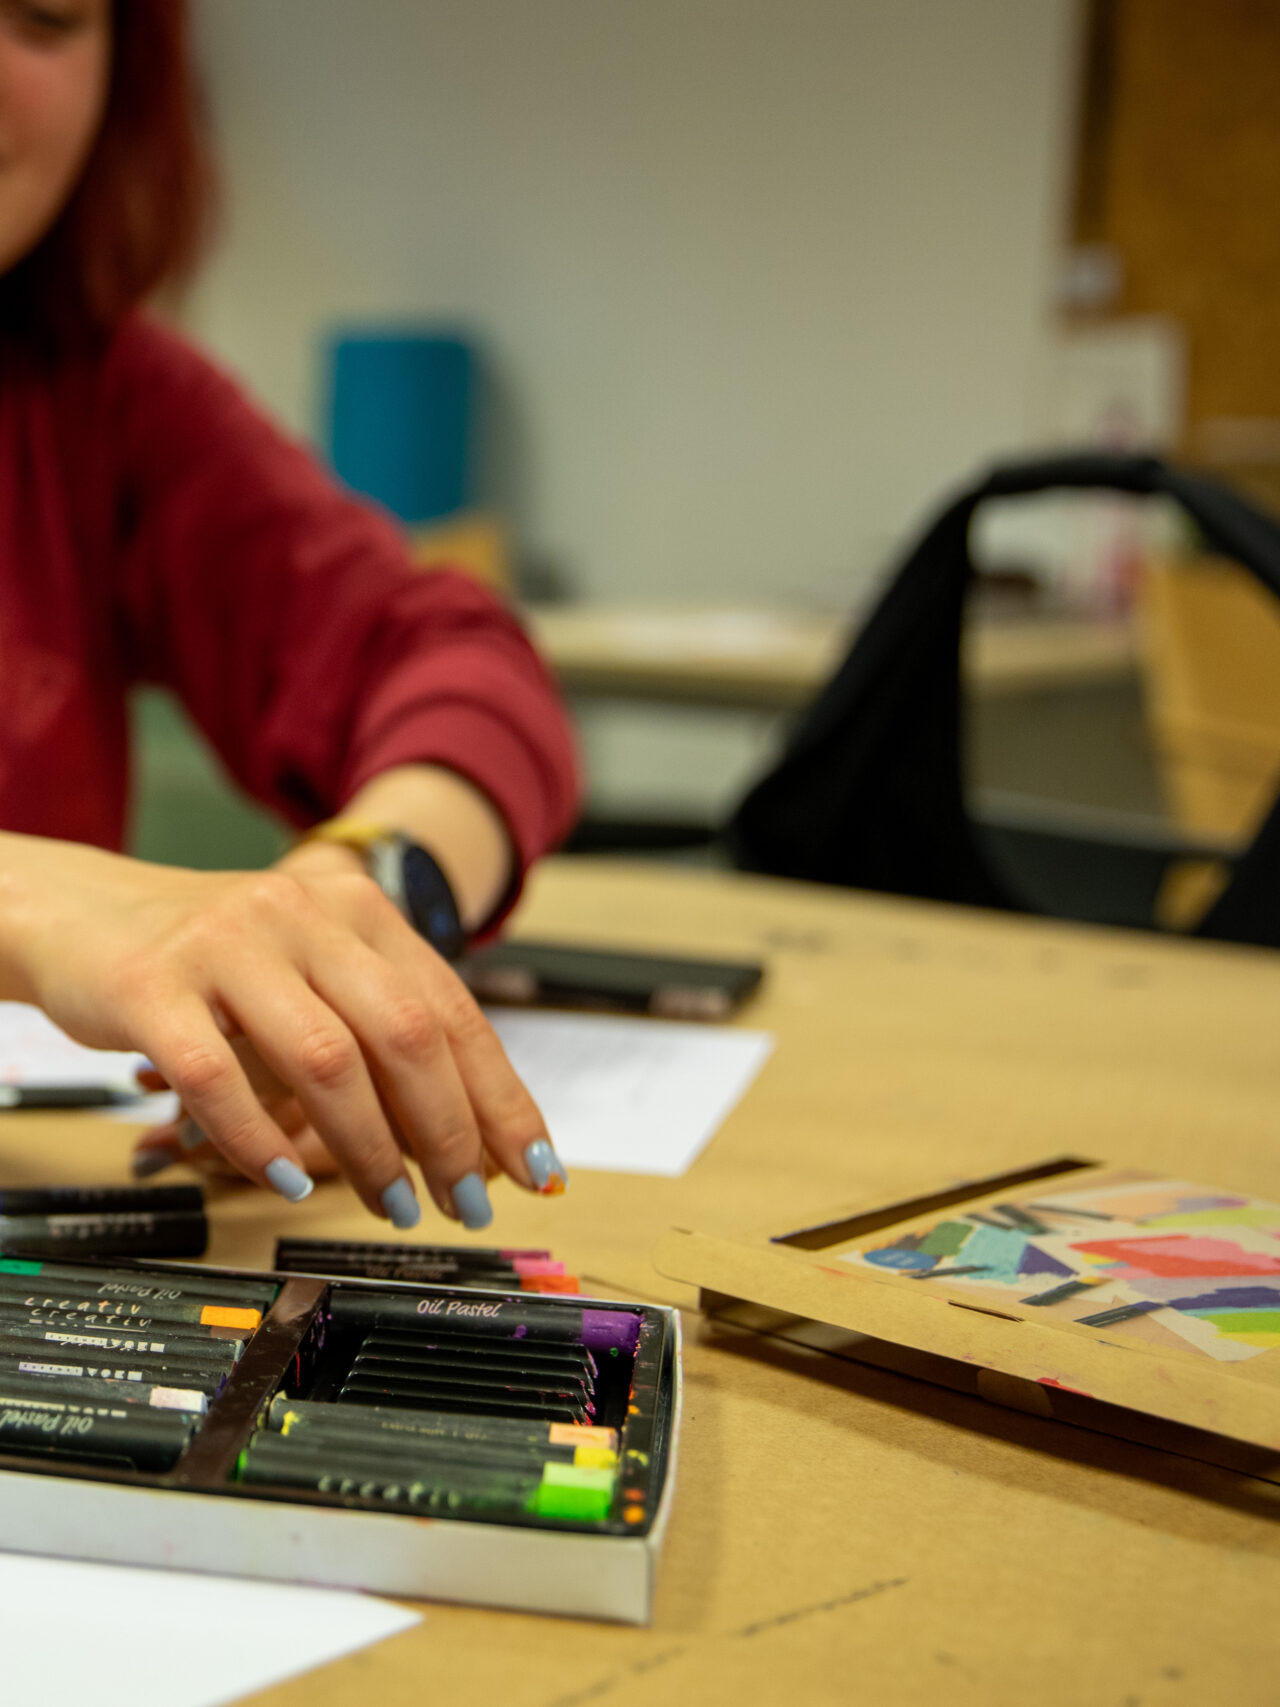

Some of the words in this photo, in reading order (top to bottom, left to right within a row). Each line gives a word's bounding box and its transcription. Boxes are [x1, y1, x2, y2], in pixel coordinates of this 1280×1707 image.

[97, 1282, 151, 1298] Pastel
[152, 1289, 182, 1300] Oil
[24, 1296, 142, 1315] creativ
[416, 1299, 445, 1314] Oil
[445, 1300, 503, 1318] Pastel
[31, 1307, 150, 1328] creativ
[60, 1415, 94, 1435] Oil
